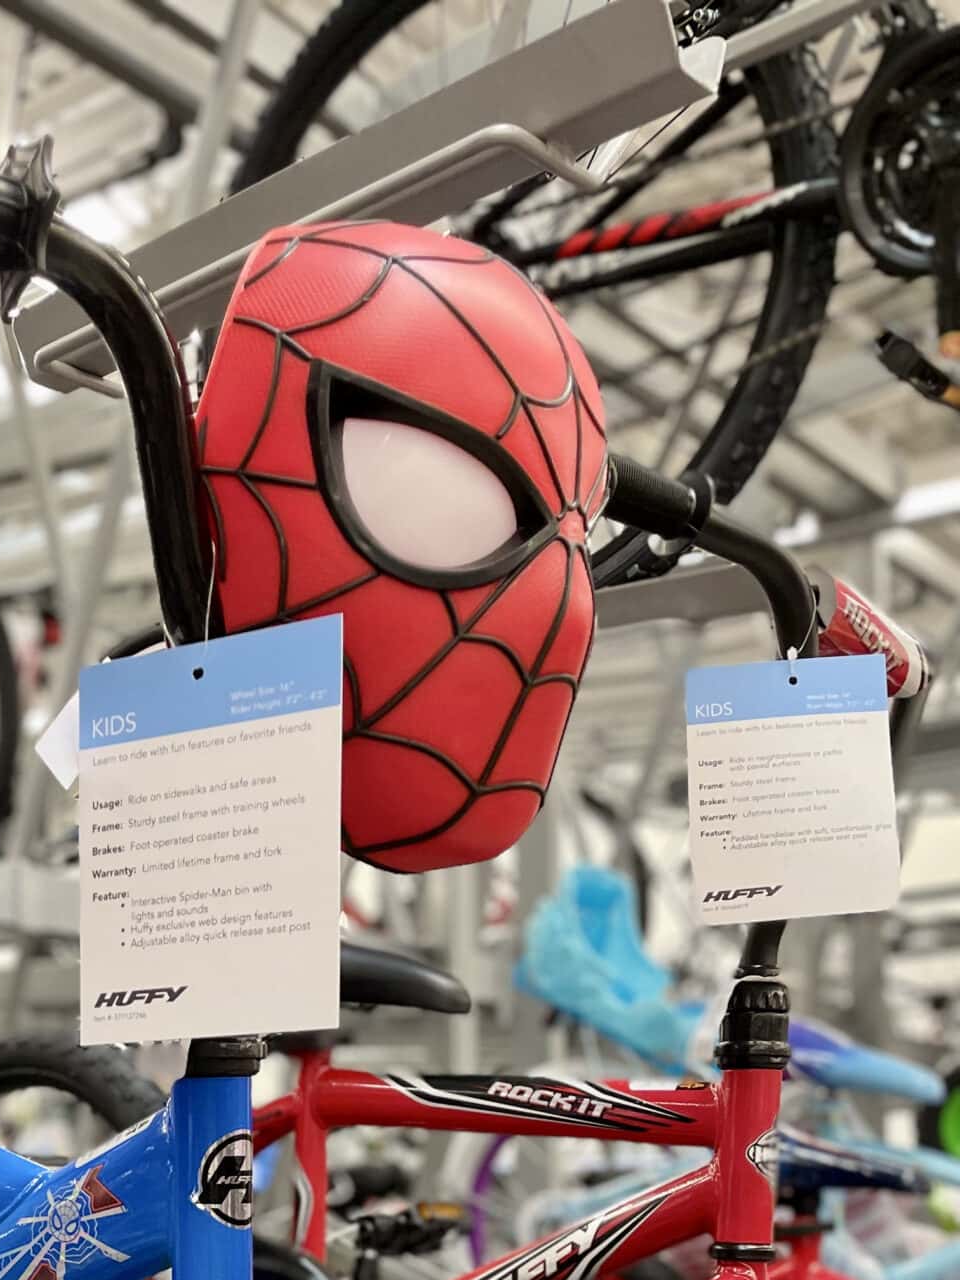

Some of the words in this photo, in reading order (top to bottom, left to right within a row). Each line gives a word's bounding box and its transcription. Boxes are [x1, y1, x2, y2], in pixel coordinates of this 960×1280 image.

[695, 702, 734, 719] KIDS
[92, 711, 137, 739] KIDS
[93, 754, 117, 768] Learn
[119, 752, 129, 762] to
[130, 748, 148, 760] ride
[150, 744, 169, 756] with
[171, 742, 186, 753] fun
[188, 736, 225, 751] features
[227, 735, 237, 744] or
[240, 728, 276, 742] favorite
[278, 720, 312, 736] friends
[92, 799, 123, 811] Usage:
[128, 793, 148, 805] Ride
[150, 792, 162, 801] on
[164, 783, 207, 799] sidewalks
[209, 782, 227, 793] and
[229, 776, 249, 789] safe
[251, 775, 277, 787] areas
[92, 822, 124, 834] Frame:
[128, 815, 157, 829] Sturdy
[158, 811, 180, 823] steel
[182, 807, 208, 821] frame
[211, 804, 230, 817] with
[233, 799, 270, 813] training
[272, 792, 305, 807] wheels
[92, 844, 125, 857] Brakes:
[130, 840, 150, 852] Foot
[152, 833, 194, 850] operated
[196, 829, 230, 843] coaster
[232, 824, 260, 839] brake
[92, 866, 137, 880] Warranty:
[142, 858, 175, 873] Limited
[178, 854, 211, 869] lifetime
[214, 852, 241, 864] frame
[243, 847, 262, 860] and
[264, 844, 282, 858] fork
[92, 890, 130, 903] Feature:
[131, 894, 177, 908] Interactive
[179, 886, 232, 904] Spider-Man
[234, 884, 250, 896] bin
[252, 881, 273, 894] with
[703, 884, 783, 903] HUFFY
[131, 909, 155, 924] lights
[157, 906, 175, 919] and
[177, 904, 209, 917] sounds
[131, 922, 153, 936] Huffy
[156, 918, 196, 932] exclusive
[199, 915, 218, 927] web
[220, 911, 252, 925] design
[254, 908, 293, 921] features
[131, 936, 178, 950] Adjustable
[180, 931, 200, 945] alloy
[203, 928, 227, 943] quick
[230, 926, 264, 939] release
[266, 922, 287, 935] seat
[289, 920, 312, 934] post
[95, 985, 189, 1009] HUFFY
[487, 1080, 577, 1113] ROCK
